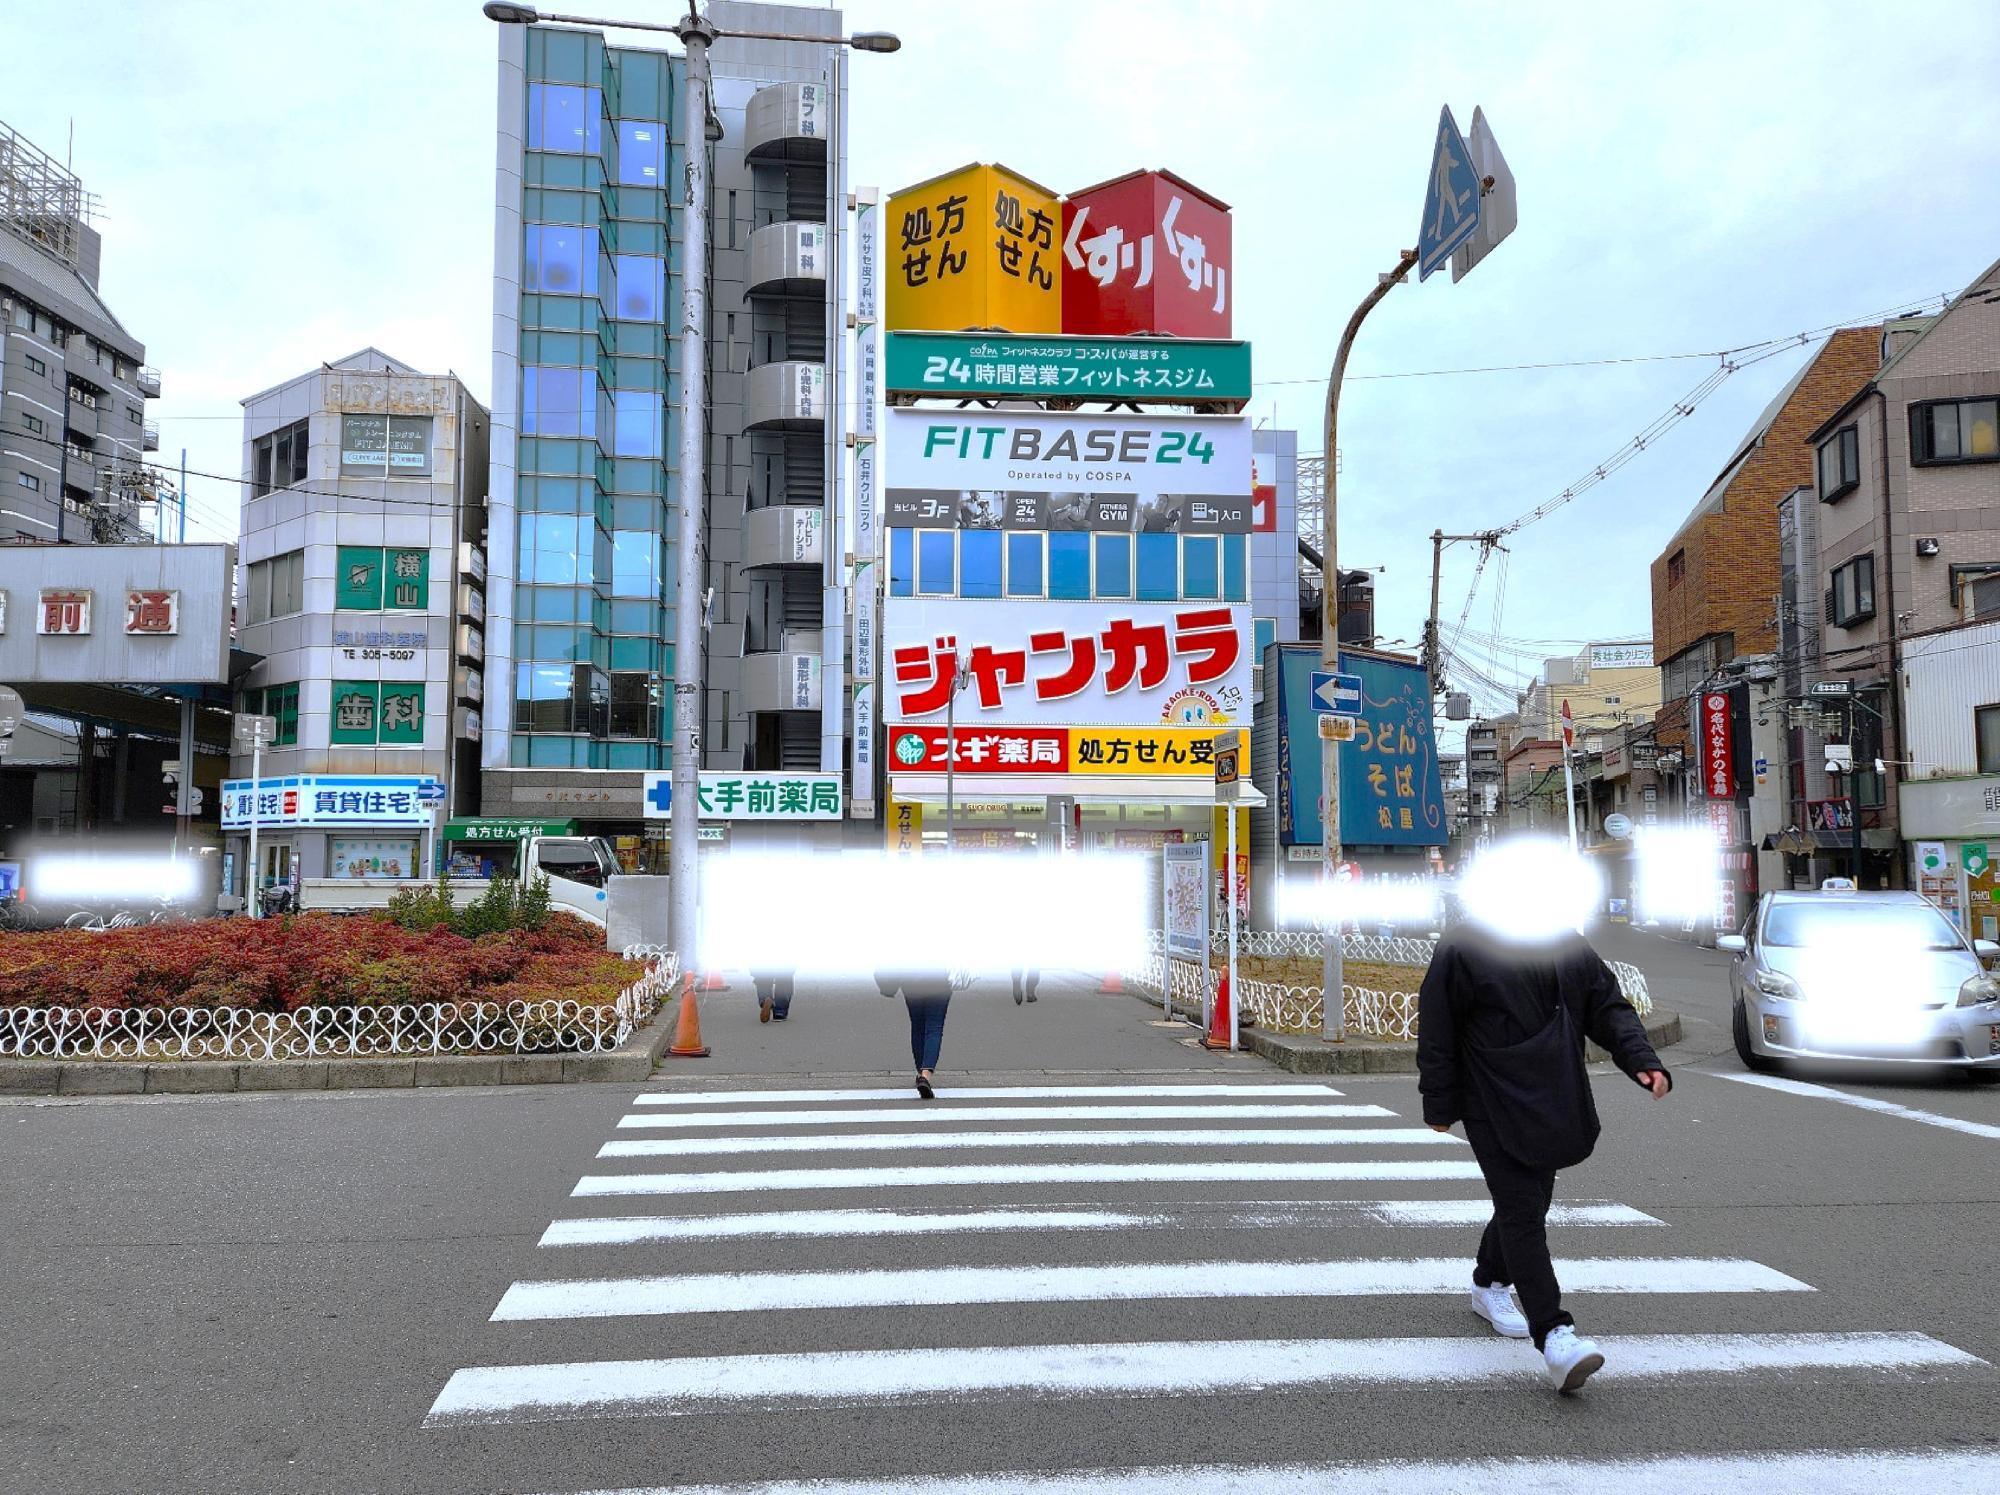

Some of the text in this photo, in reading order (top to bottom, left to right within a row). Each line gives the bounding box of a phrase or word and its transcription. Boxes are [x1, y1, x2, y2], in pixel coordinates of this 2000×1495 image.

[802, 85, 815, 136] 皮フ科
[902, 195, 968, 250] 処方
[995, 190, 1054, 250] 処方
[801, 232, 814, 270] 眼科
[862, 232, 872, 299] ササセ皮フ科
[902, 240, 967, 287] せん
[995, 236, 1052, 291] せん
[1063, 207, 1153, 288] くすり
[1161, 196, 1226, 314] くすり
[1001, 347, 1072, 357] フィットネスクラブ
[923, 356, 1214, 389] 24時間営業フィットネスジム
[1008, 470, 1132, 482] Operated by COSPA
[860, 458, 871, 531] 石井クリニック
[894, 499, 949, 519] 当ビル 3F
[1016, 506, 1036, 516] 24
[1100, 511, 1128, 521] GYM
[1221, 510, 1241, 520] 入口
[395, 552, 421, 606] 横山
[41, 592, 172, 633] 前通
[362, 650, 415, 660] 305-5097
[894, 608, 1241, 716] ジャンカラ
[336, 693, 422, 731] 歯科
[931, 736, 1060, 764] スギ薬局
[1078, 738, 1214, 765] 処方せん受
[1351, 720, 1416, 754] うどん
[1367, 763, 1416, 797] そば
[314, 791, 410, 814] 賃貸住宅
[465, 827, 544, 838] 処方せん受付
